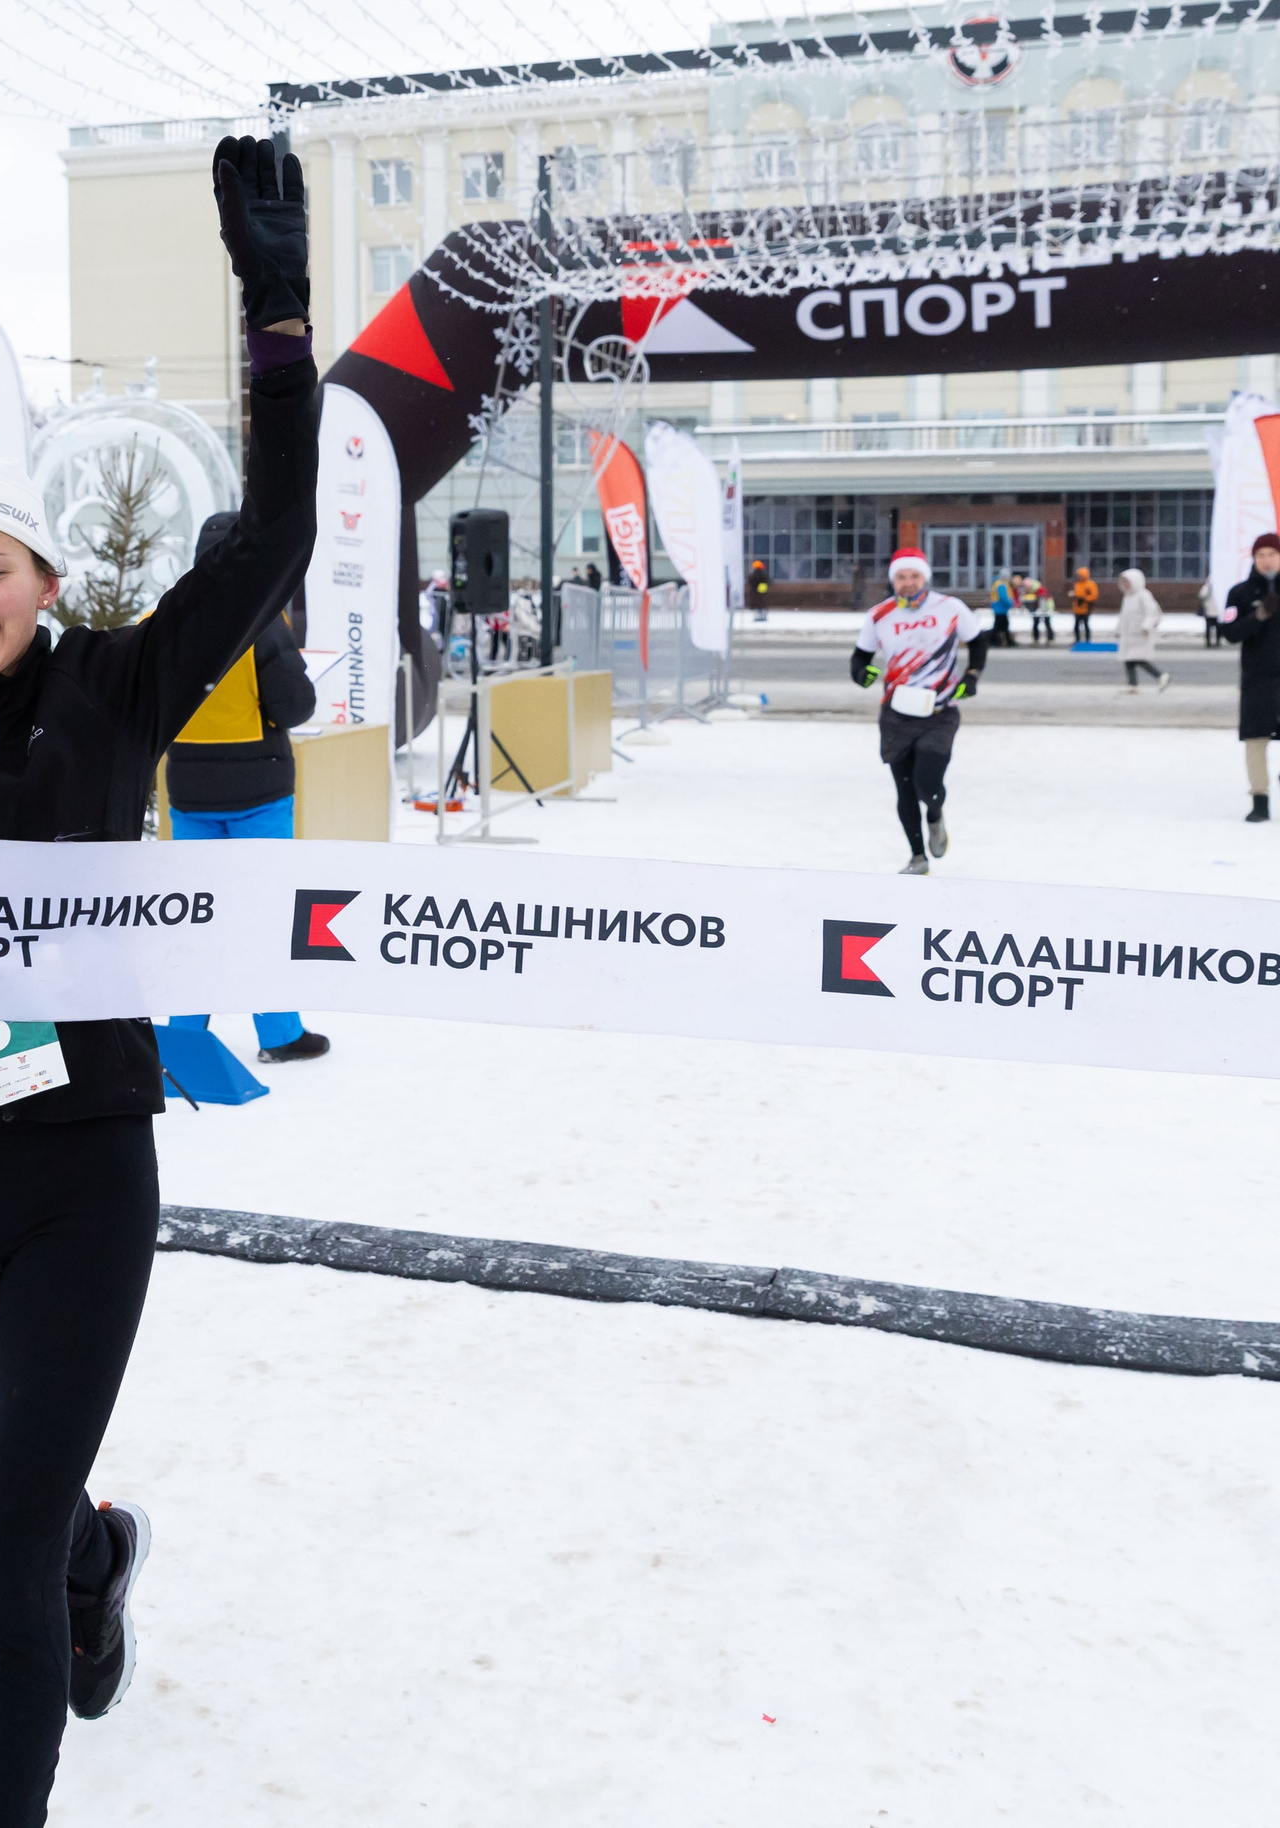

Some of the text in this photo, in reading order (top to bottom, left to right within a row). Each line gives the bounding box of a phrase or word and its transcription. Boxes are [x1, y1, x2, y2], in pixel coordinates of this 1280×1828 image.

[796, 276, 1067, 341] СПОРТ
[383, 893, 725, 948] КАЛАШНИКОВ
[380, 931, 532, 973] СПОРТ
[924, 927, 1280, 986] КАЛАШНИКОВ
[921, 967, 1084, 1010] СПОРТ
